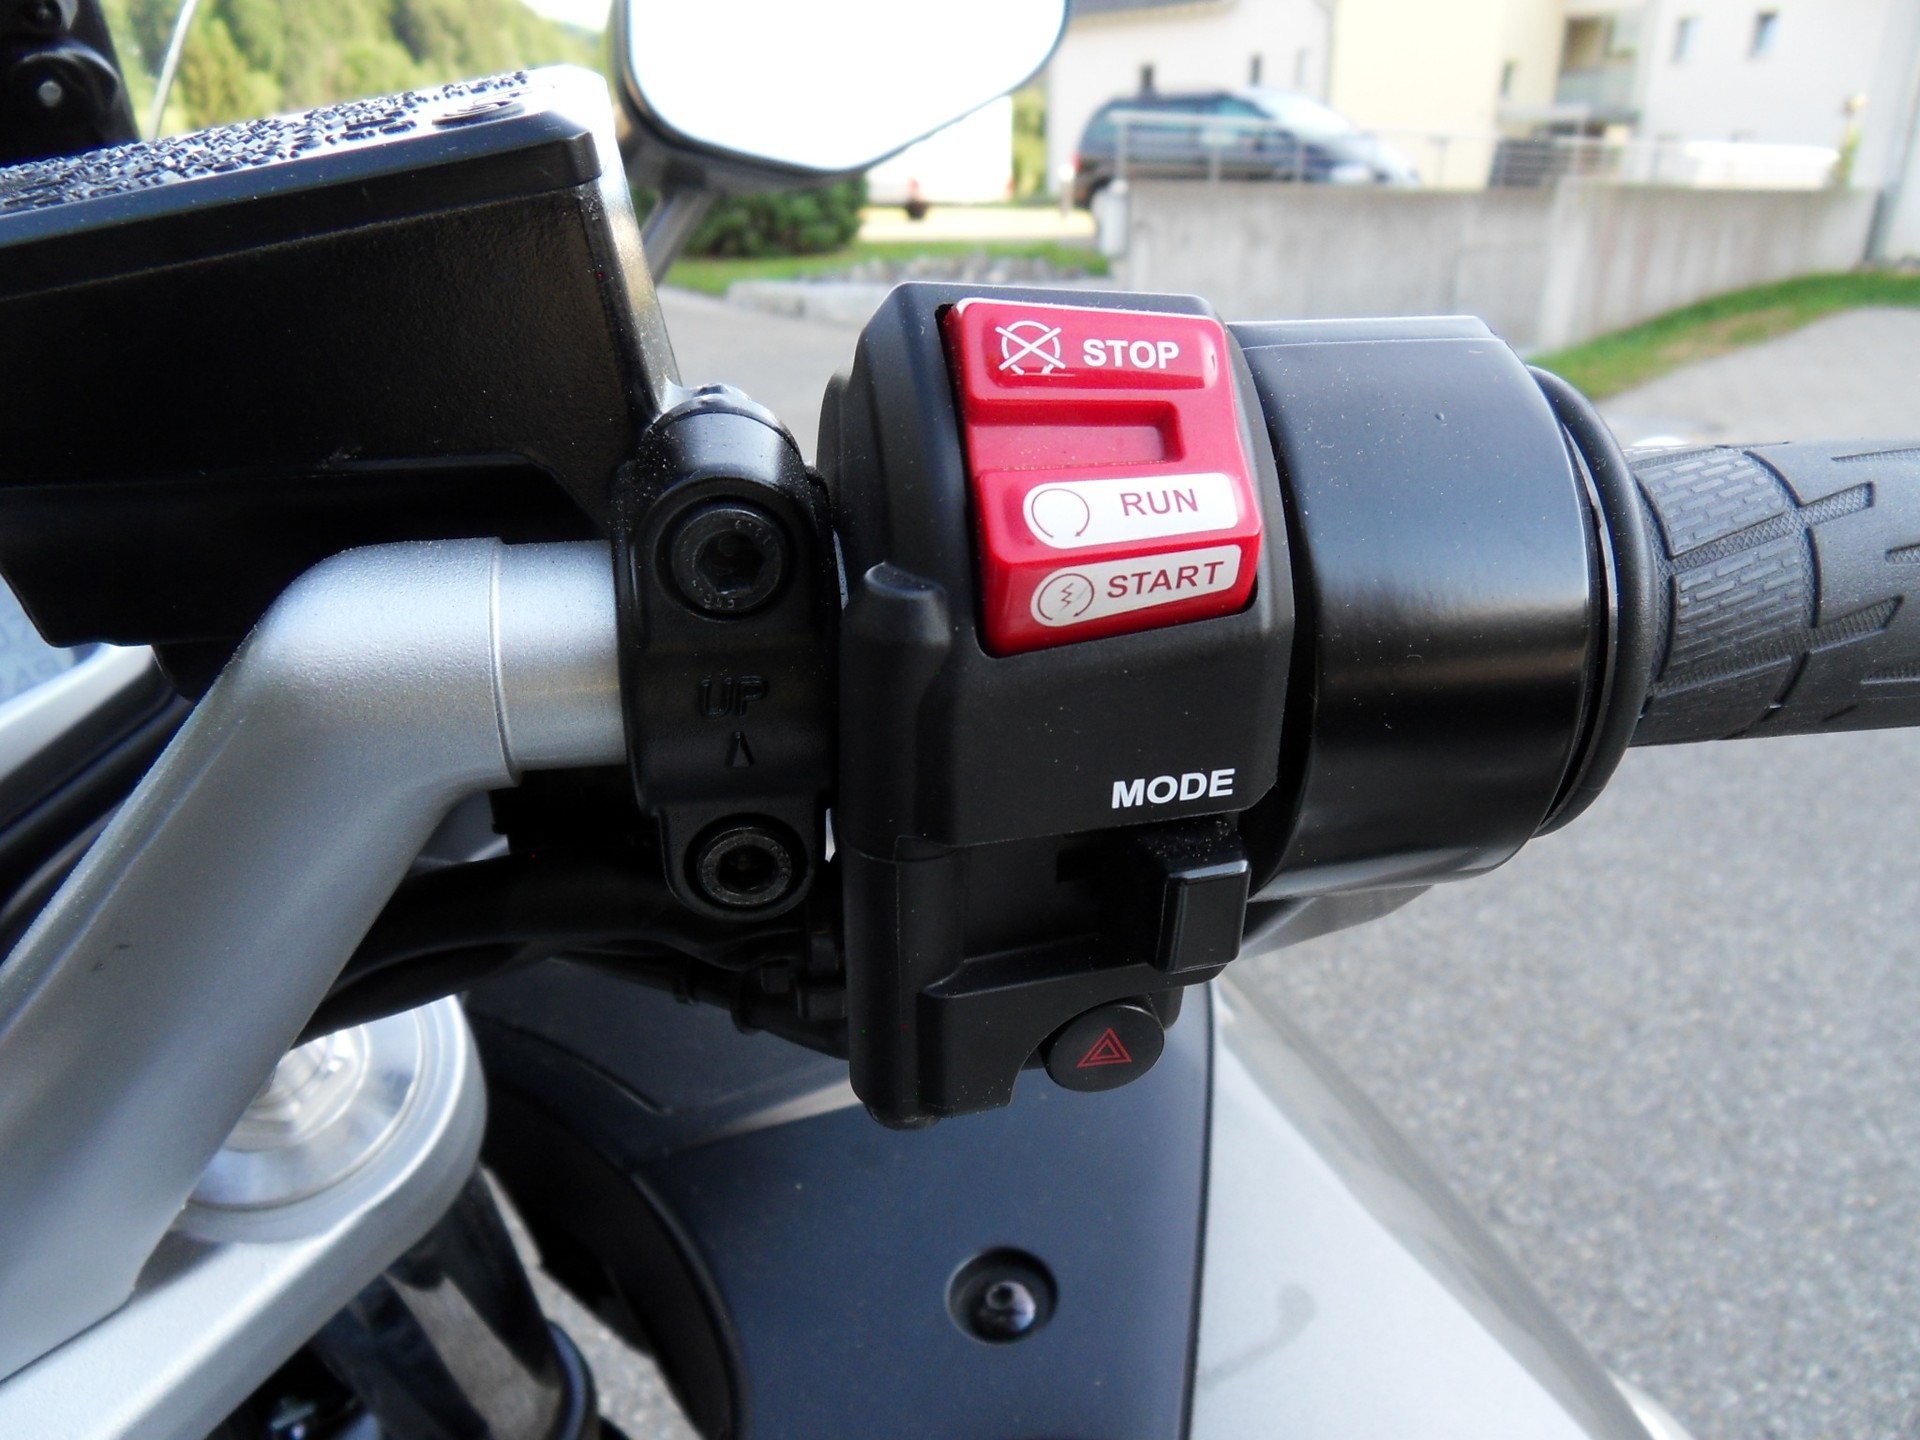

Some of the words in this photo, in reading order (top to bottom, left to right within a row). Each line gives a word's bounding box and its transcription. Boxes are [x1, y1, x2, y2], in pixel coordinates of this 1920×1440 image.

[1083, 339, 1179, 369] STOP
[1120, 488, 1198, 517] RUN
[1107, 561, 1224, 599] START
[699, 676, 767, 718] UP
[1112, 768, 1235, 809] MODE
